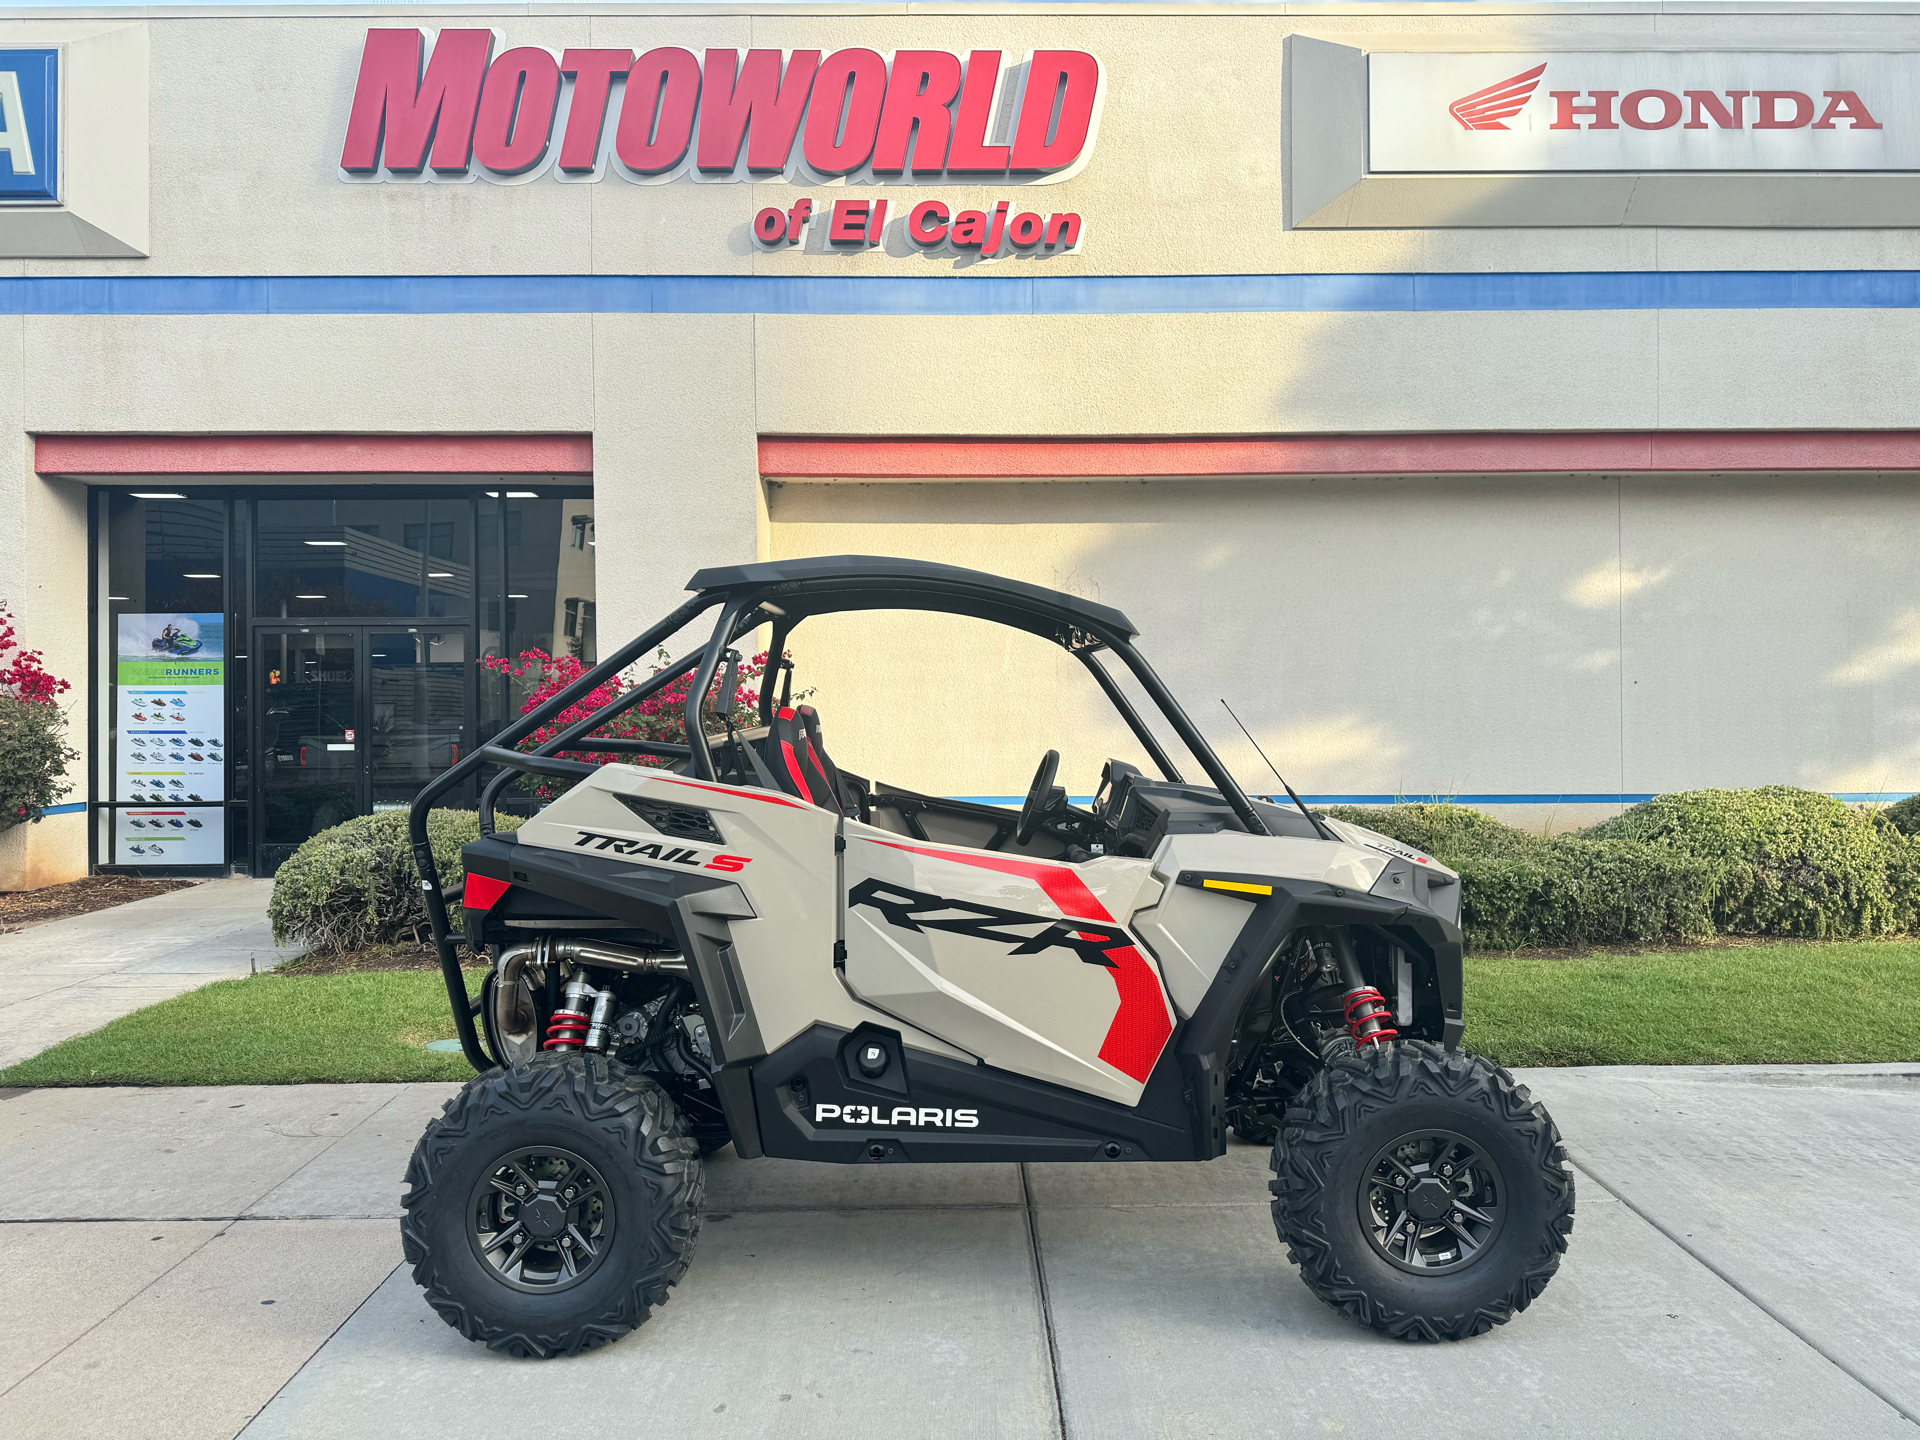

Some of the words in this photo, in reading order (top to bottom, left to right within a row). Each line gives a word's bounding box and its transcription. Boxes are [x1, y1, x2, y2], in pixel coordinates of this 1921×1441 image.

[340, 27, 1099, 175] MOTOWORLD
[1549, 89, 1883, 131] HONDA
[754, 198, 812, 245] of
[829, 199, 889, 246] El
[908, 199, 1082, 259] Cajon
[574, 831, 701, 866] TRAIL
[703, 854, 753, 872] S
[1377, 842, 1415, 860] TRAIL
[848, 877, 1136, 969] RZR
[815, 1103, 979, 1128] POLARIS
